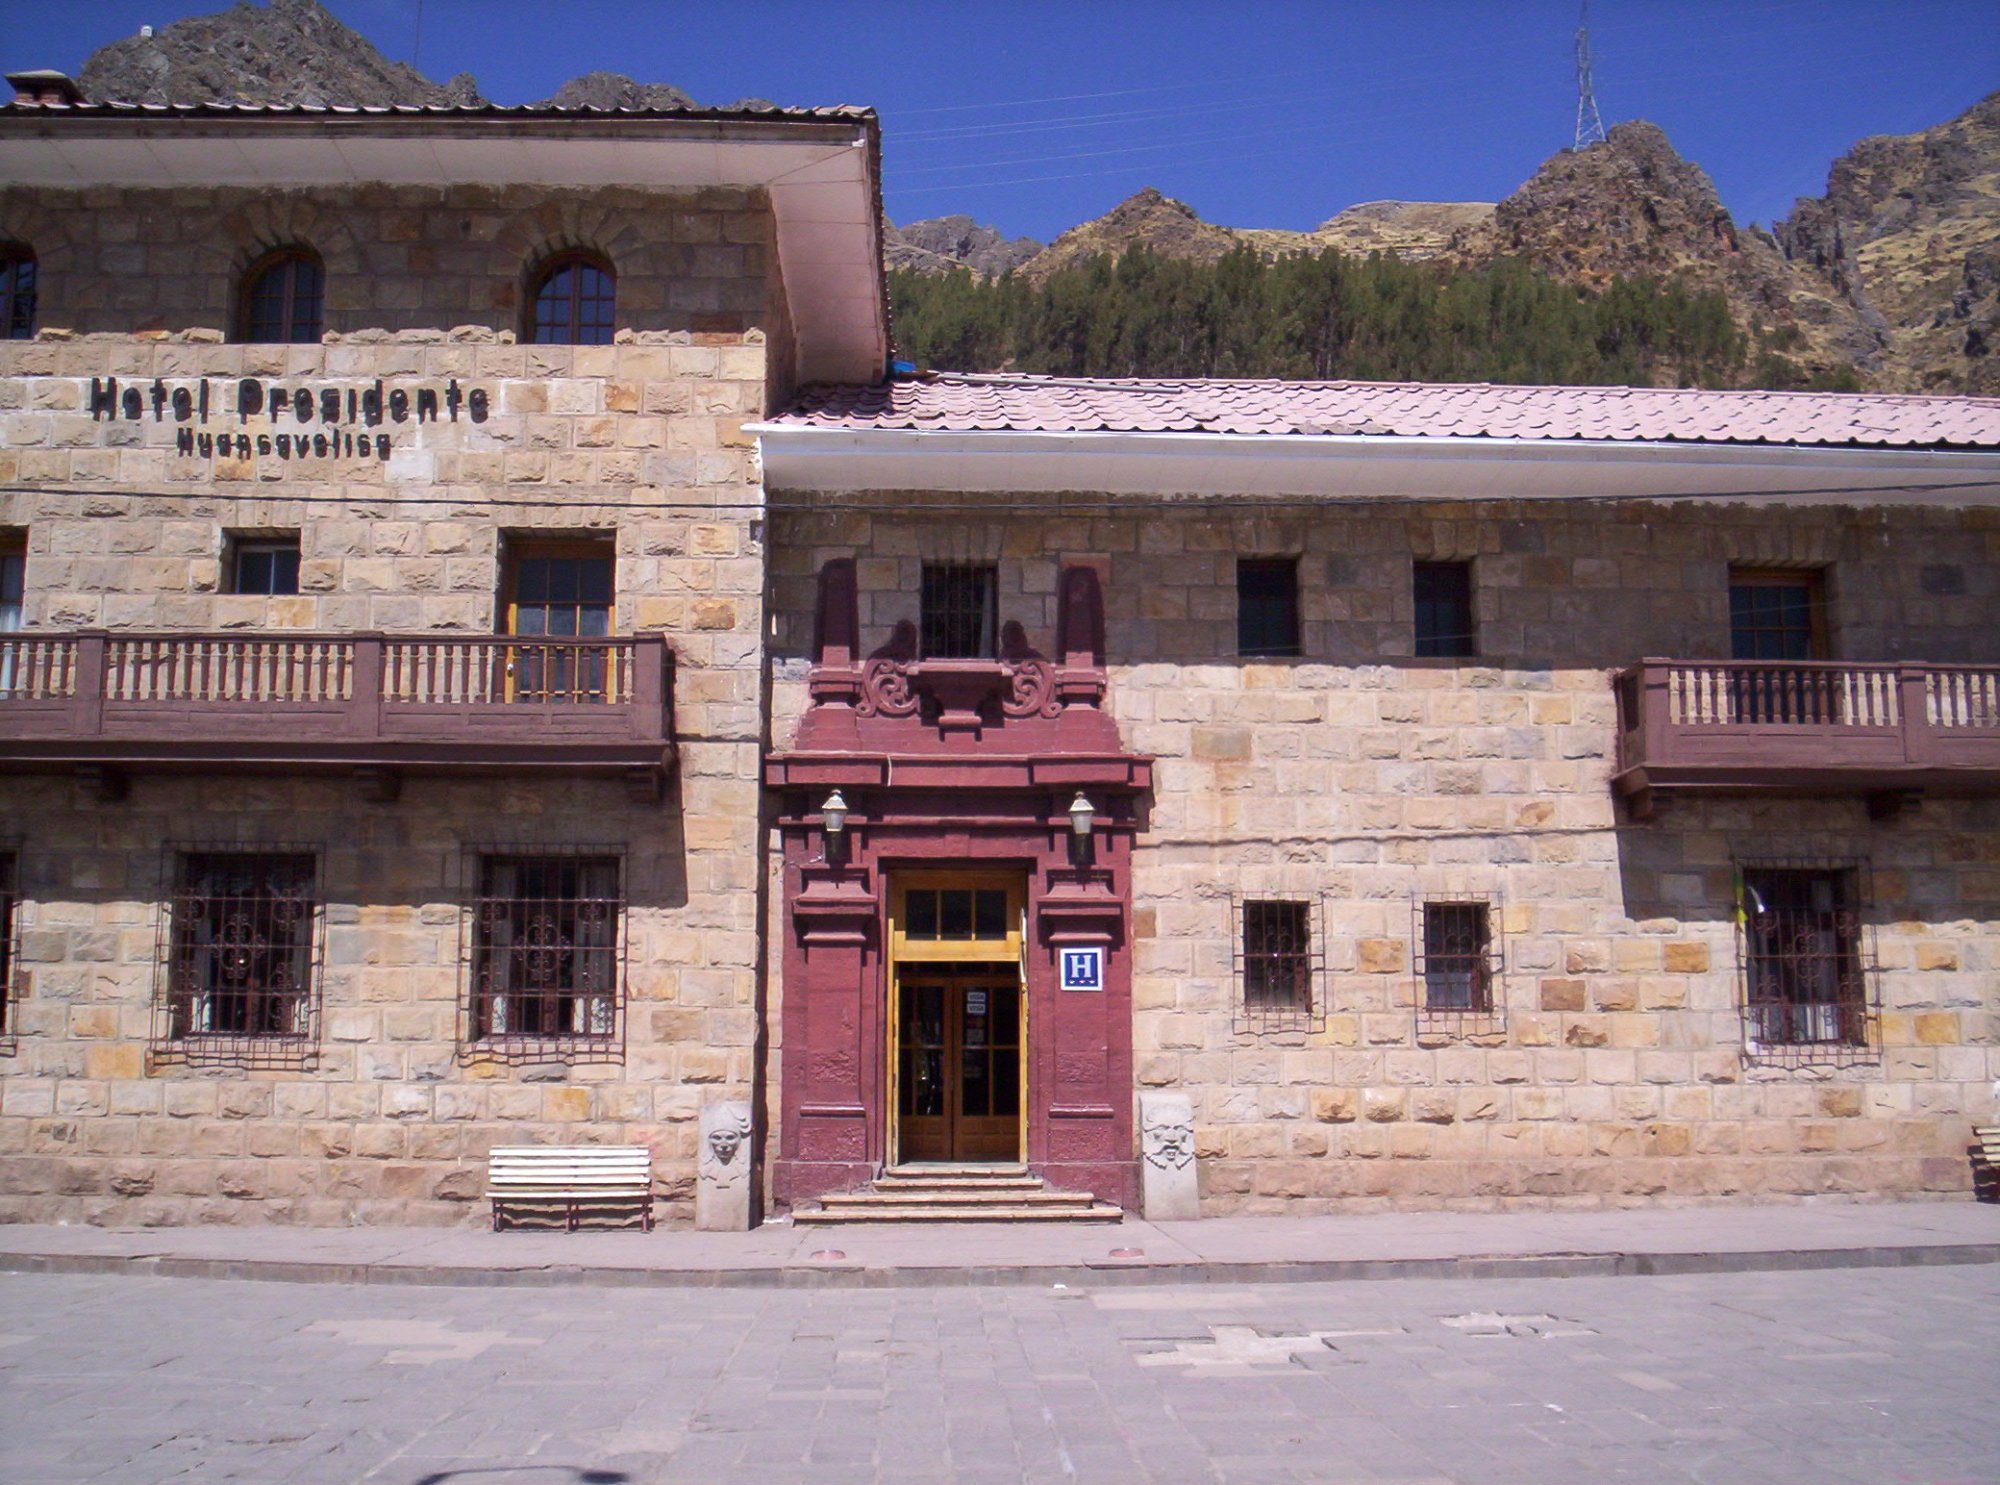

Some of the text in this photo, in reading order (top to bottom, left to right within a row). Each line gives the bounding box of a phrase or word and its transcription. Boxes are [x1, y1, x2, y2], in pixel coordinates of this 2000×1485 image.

[91, 376, 489, 424] Hotel Presidente
[177, 428, 391, 461] Huancavelica
[1070, 955, 1092, 978] H
